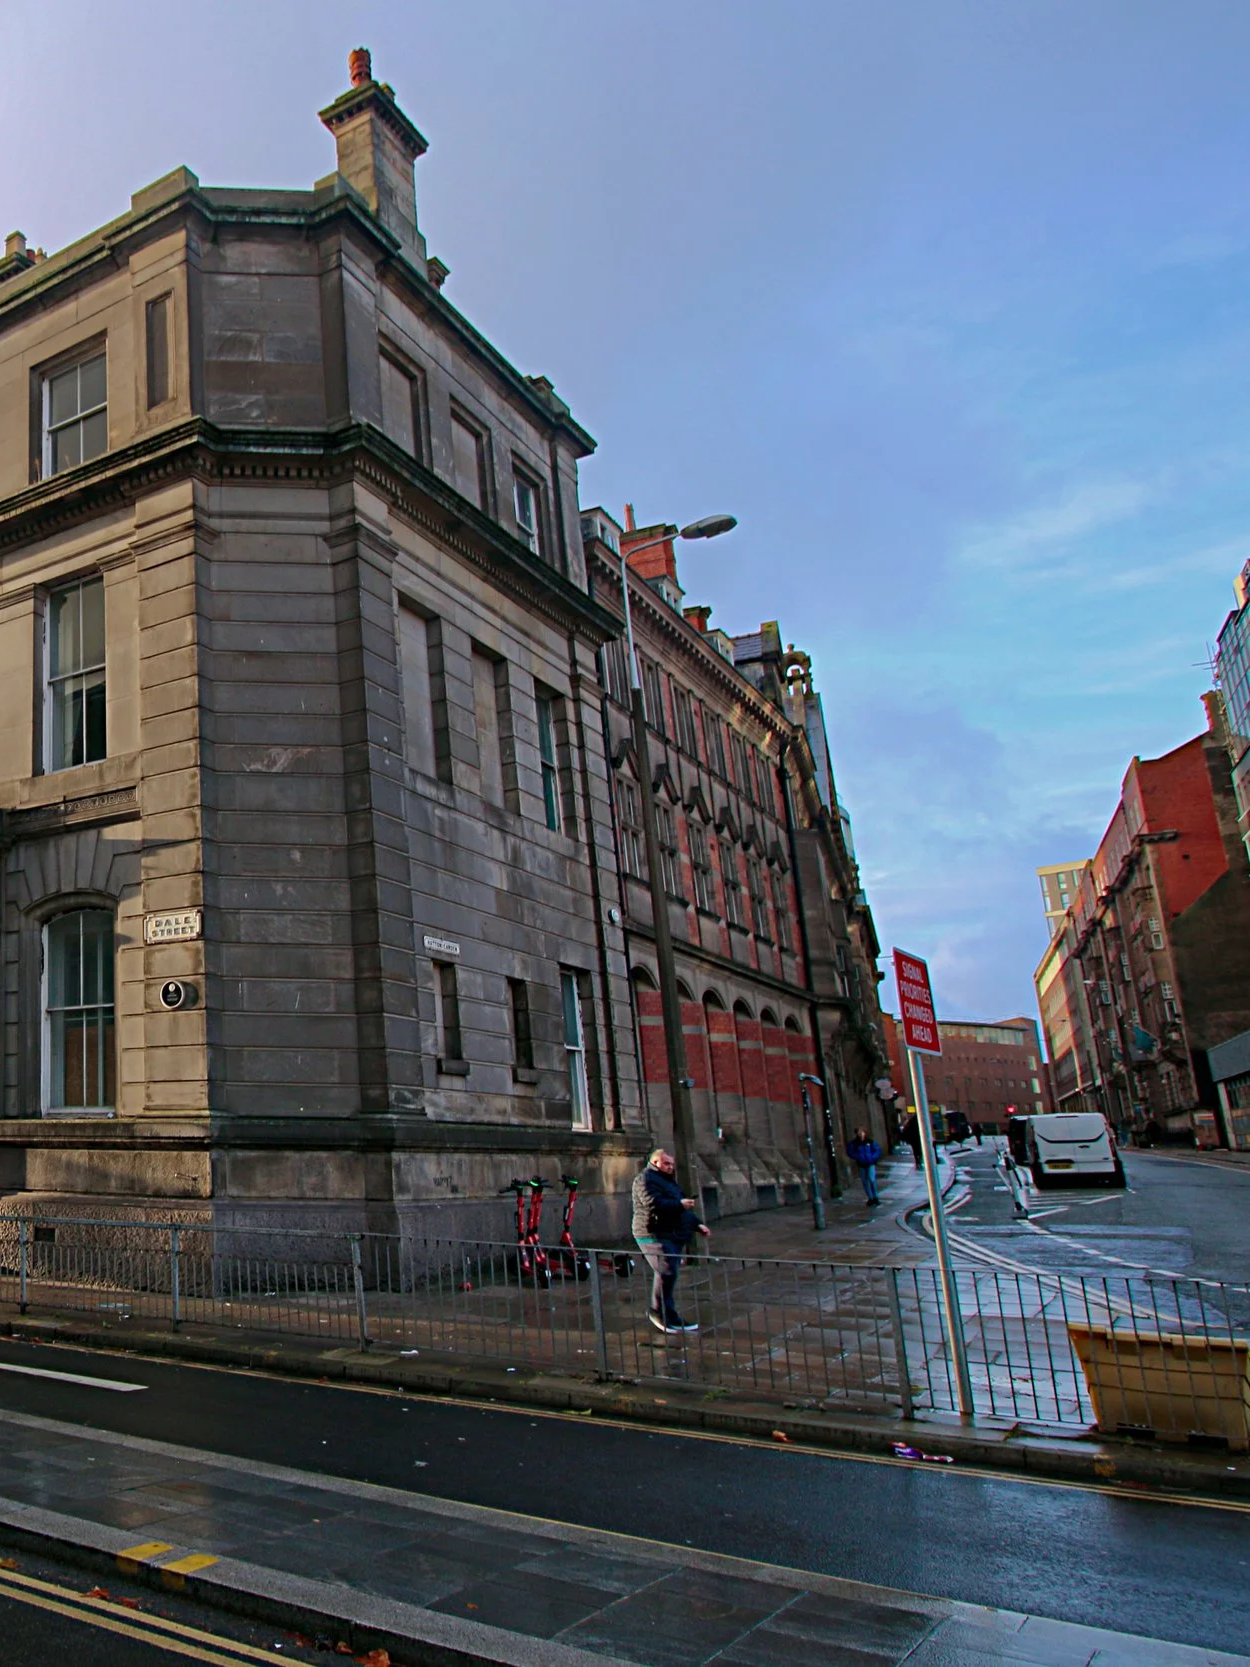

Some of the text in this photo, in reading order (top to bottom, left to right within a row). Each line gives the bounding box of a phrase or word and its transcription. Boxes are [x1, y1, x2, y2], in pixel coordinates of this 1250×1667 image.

[152, 926, 195, 937] STREET
[155, 917, 191, 927] DALE
[902, 961, 924, 983] SIGNAL
[899, 980, 931, 1004] PRIORITIES
[904, 1001, 933, 1024] CHANGED
[912, 1024, 932, 1043] AHEAD
